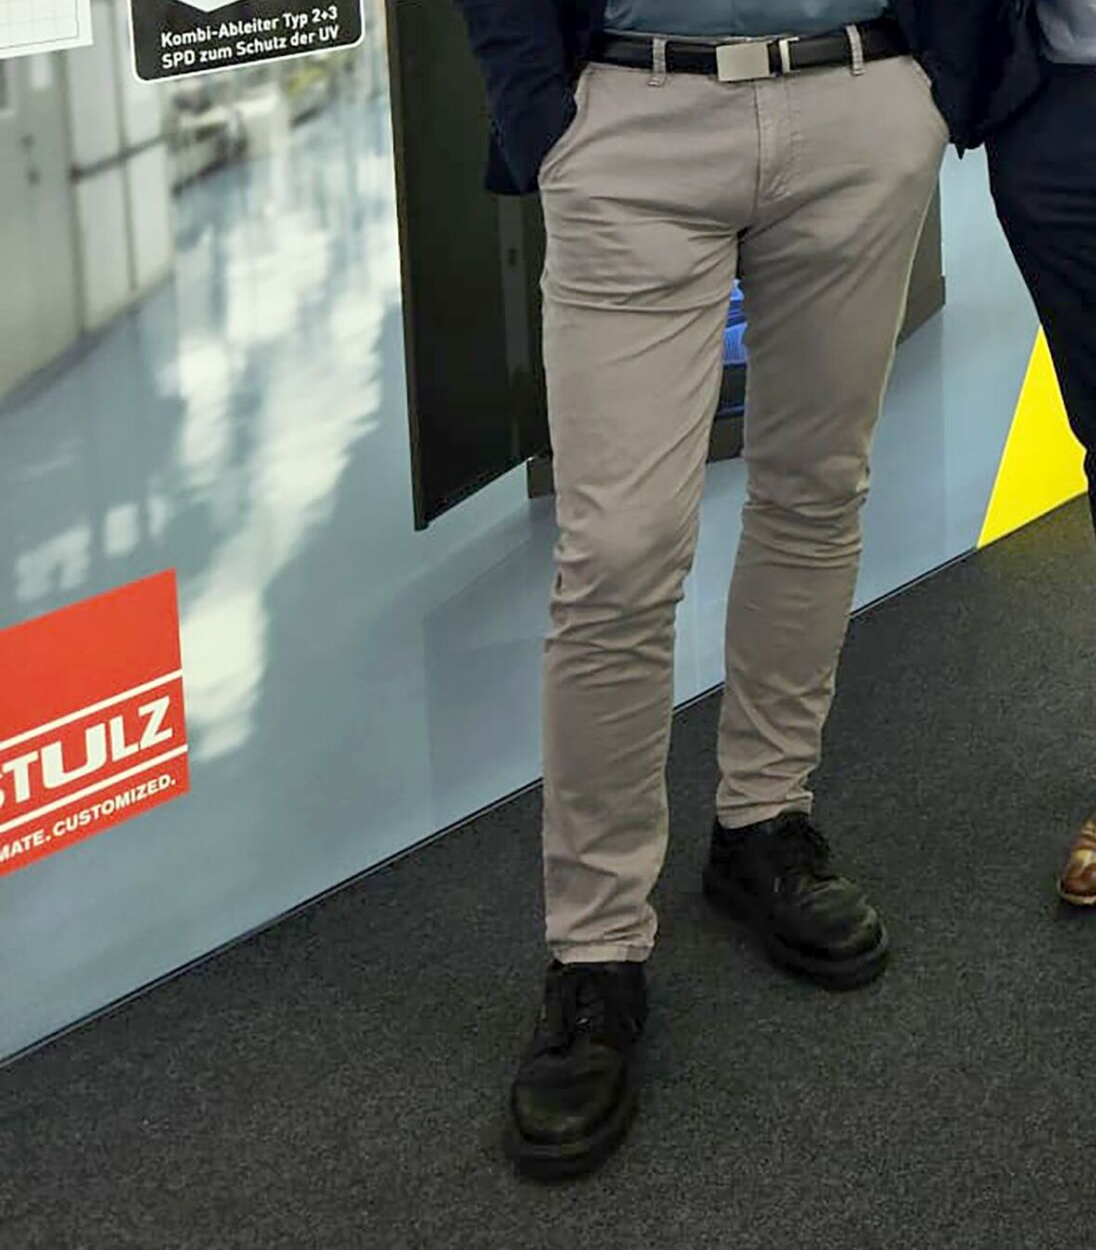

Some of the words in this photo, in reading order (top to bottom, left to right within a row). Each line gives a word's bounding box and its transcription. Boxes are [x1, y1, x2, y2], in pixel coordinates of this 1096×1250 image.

[161, 17, 279, 48] Kombi-Ableiter
[283, 13, 308, 30] Typ
[312, 5, 338, 22] 2+3
[161, 52, 195, 69] SPD
[200, 47, 232, 63] zum
[236, 37, 287, 56] Schutz
[290, 32, 316, 47] der
[319, 25, 340, 41] UV
[0, 696, 173, 807] TULZ
[53, 773, 176, 837] CUSTOMIZED.
